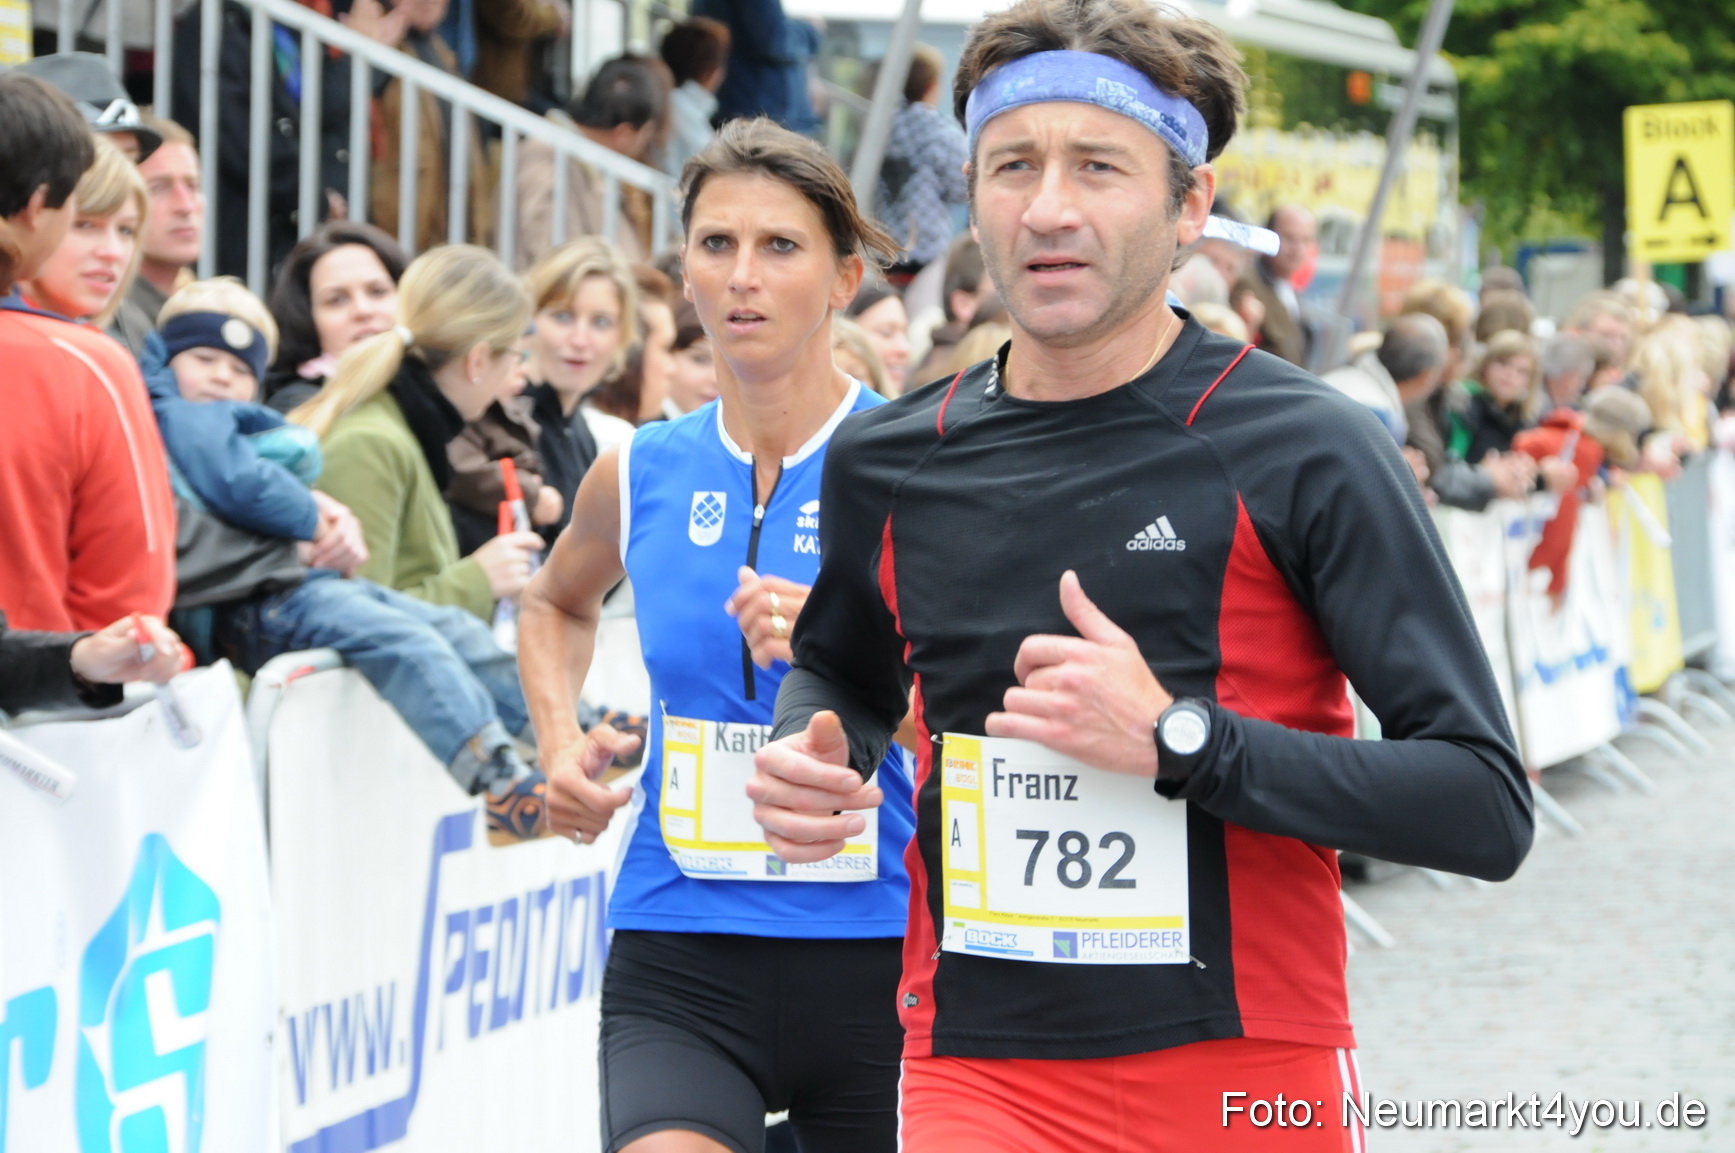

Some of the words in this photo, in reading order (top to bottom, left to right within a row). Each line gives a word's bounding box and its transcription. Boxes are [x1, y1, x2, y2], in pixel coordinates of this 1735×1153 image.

[1643, 114, 1719, 140] Block
[1658, 155, 1708, 222] A
[1126, 536, 1186, 551] adidas
[669, 765, 679, 790] A
[993, 757, 1079, 802] Franz
[951, 818, 962, 848] A
[1016, 828, 1138, 890] 782
[965, 928, 1018, 949] BOCK
[1081, 930, 1184, 950] PFLEIDERER
